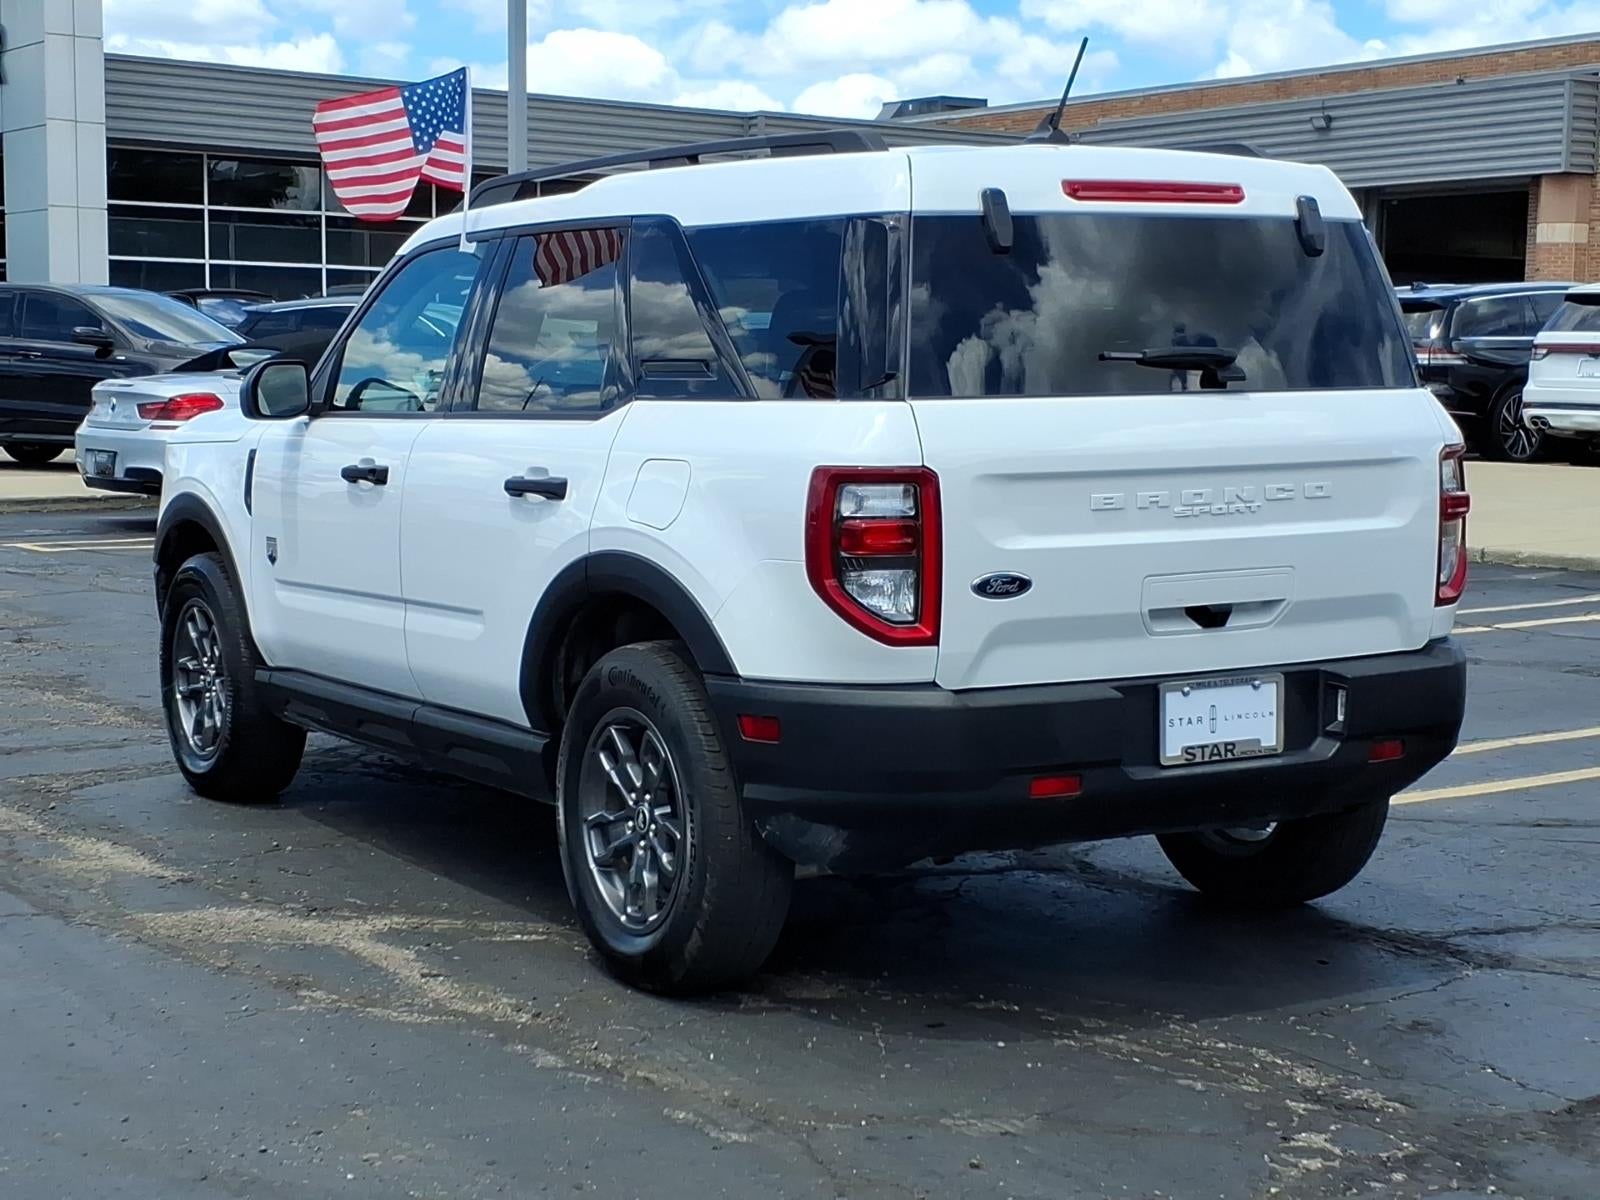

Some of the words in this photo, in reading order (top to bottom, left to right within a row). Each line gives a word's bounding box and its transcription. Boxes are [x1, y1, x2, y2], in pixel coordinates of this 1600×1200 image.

[1090, 481, 1332, 511] BRONCO
[1174, 502, 1262, 518] SPORT
[986, 577, 1020, 593] Ford
[607, 666, 662, 708] Continental
[1168, 715, 1203, 728] STAR
[1224, 711, 1274, 721] LINCOLN
[1184, 742, 1236, 762] STAR
